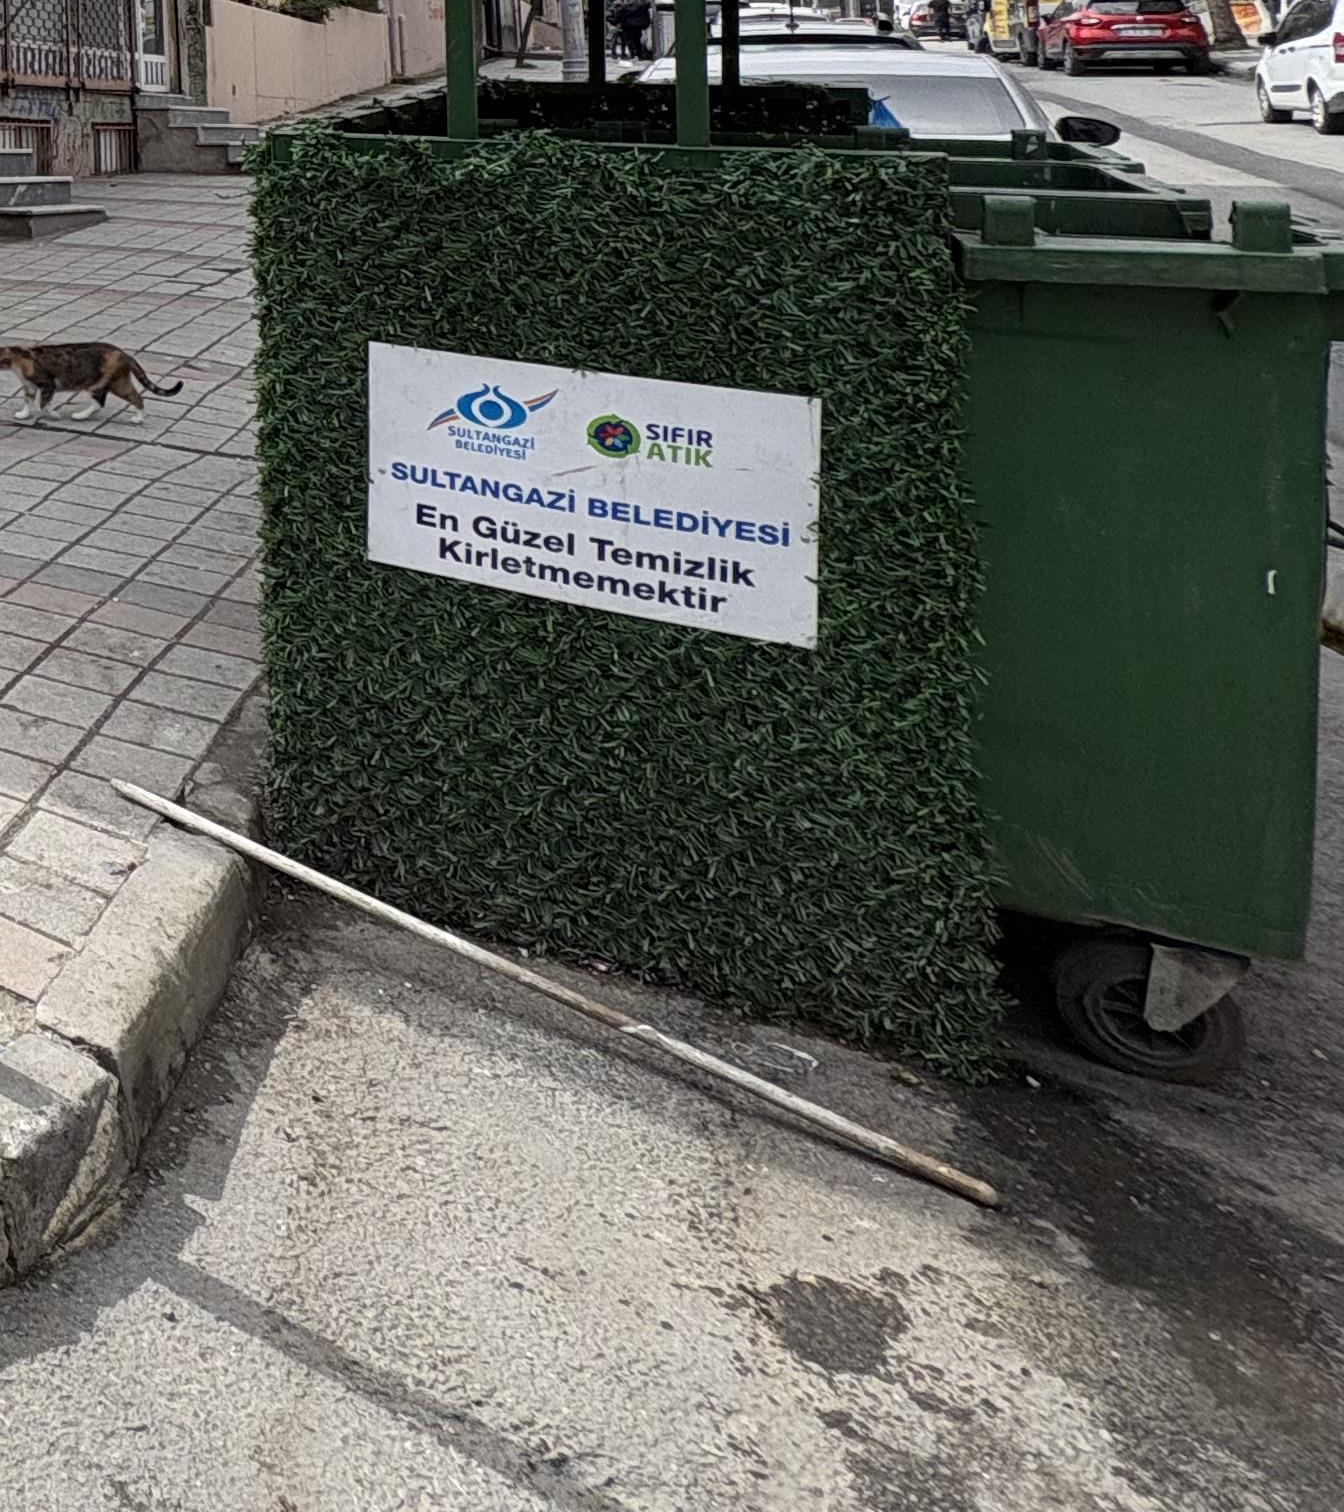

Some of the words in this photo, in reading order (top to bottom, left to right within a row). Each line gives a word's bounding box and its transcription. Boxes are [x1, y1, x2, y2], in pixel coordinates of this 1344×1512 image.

[448, 425, 535, 451] SULTANGAZİ
[646, 423, 714, 448] SIFIR
[455, 439, 527, 461] BELEDİYESİ
[646, 443, 713, 468] ATIK
[391, 462, 576, 514] SULTANGAZİ
[588, 498, 791, 548] BELEDİYESİ
[416, 503, 459, 532] En
[472, 514, 575, 556] Güzel
[589, 536, 755, 587] Temizlik
[439, 536, 727, 613] Kirletmemektir
